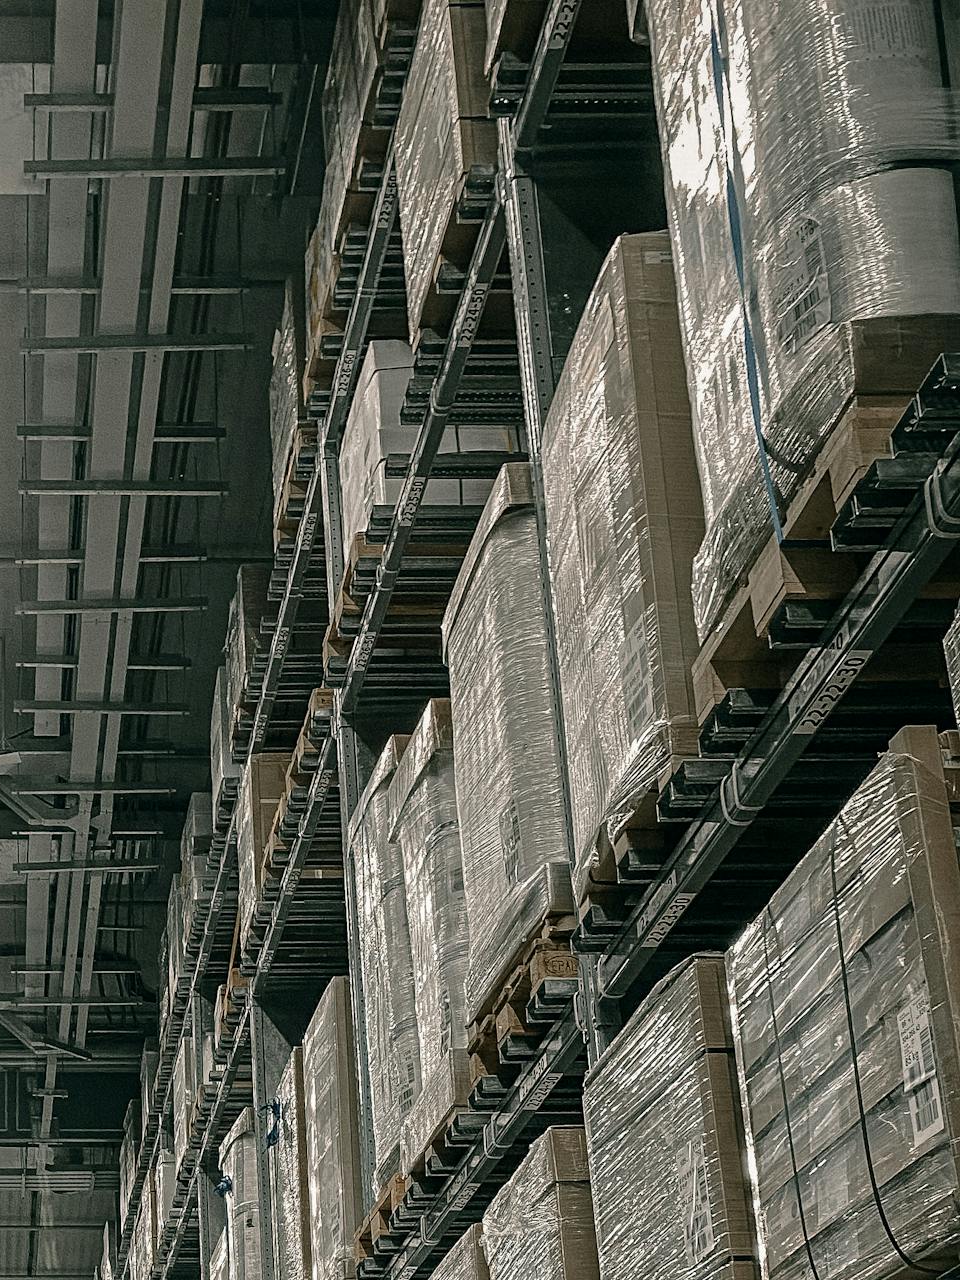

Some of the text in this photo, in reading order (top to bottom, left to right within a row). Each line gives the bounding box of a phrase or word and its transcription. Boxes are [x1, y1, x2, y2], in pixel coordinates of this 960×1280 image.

[461, 289, 485, 341] 22-24-50
[339, 354, 354, 391] 22-26-60
[402, 481, 424, 522] 22-25-50
[801, 658, 865, 726] 22-22-30
[646, 898, 690, 942] 22-23-30
[528, 1076, 559, 1110] 22-24-30
